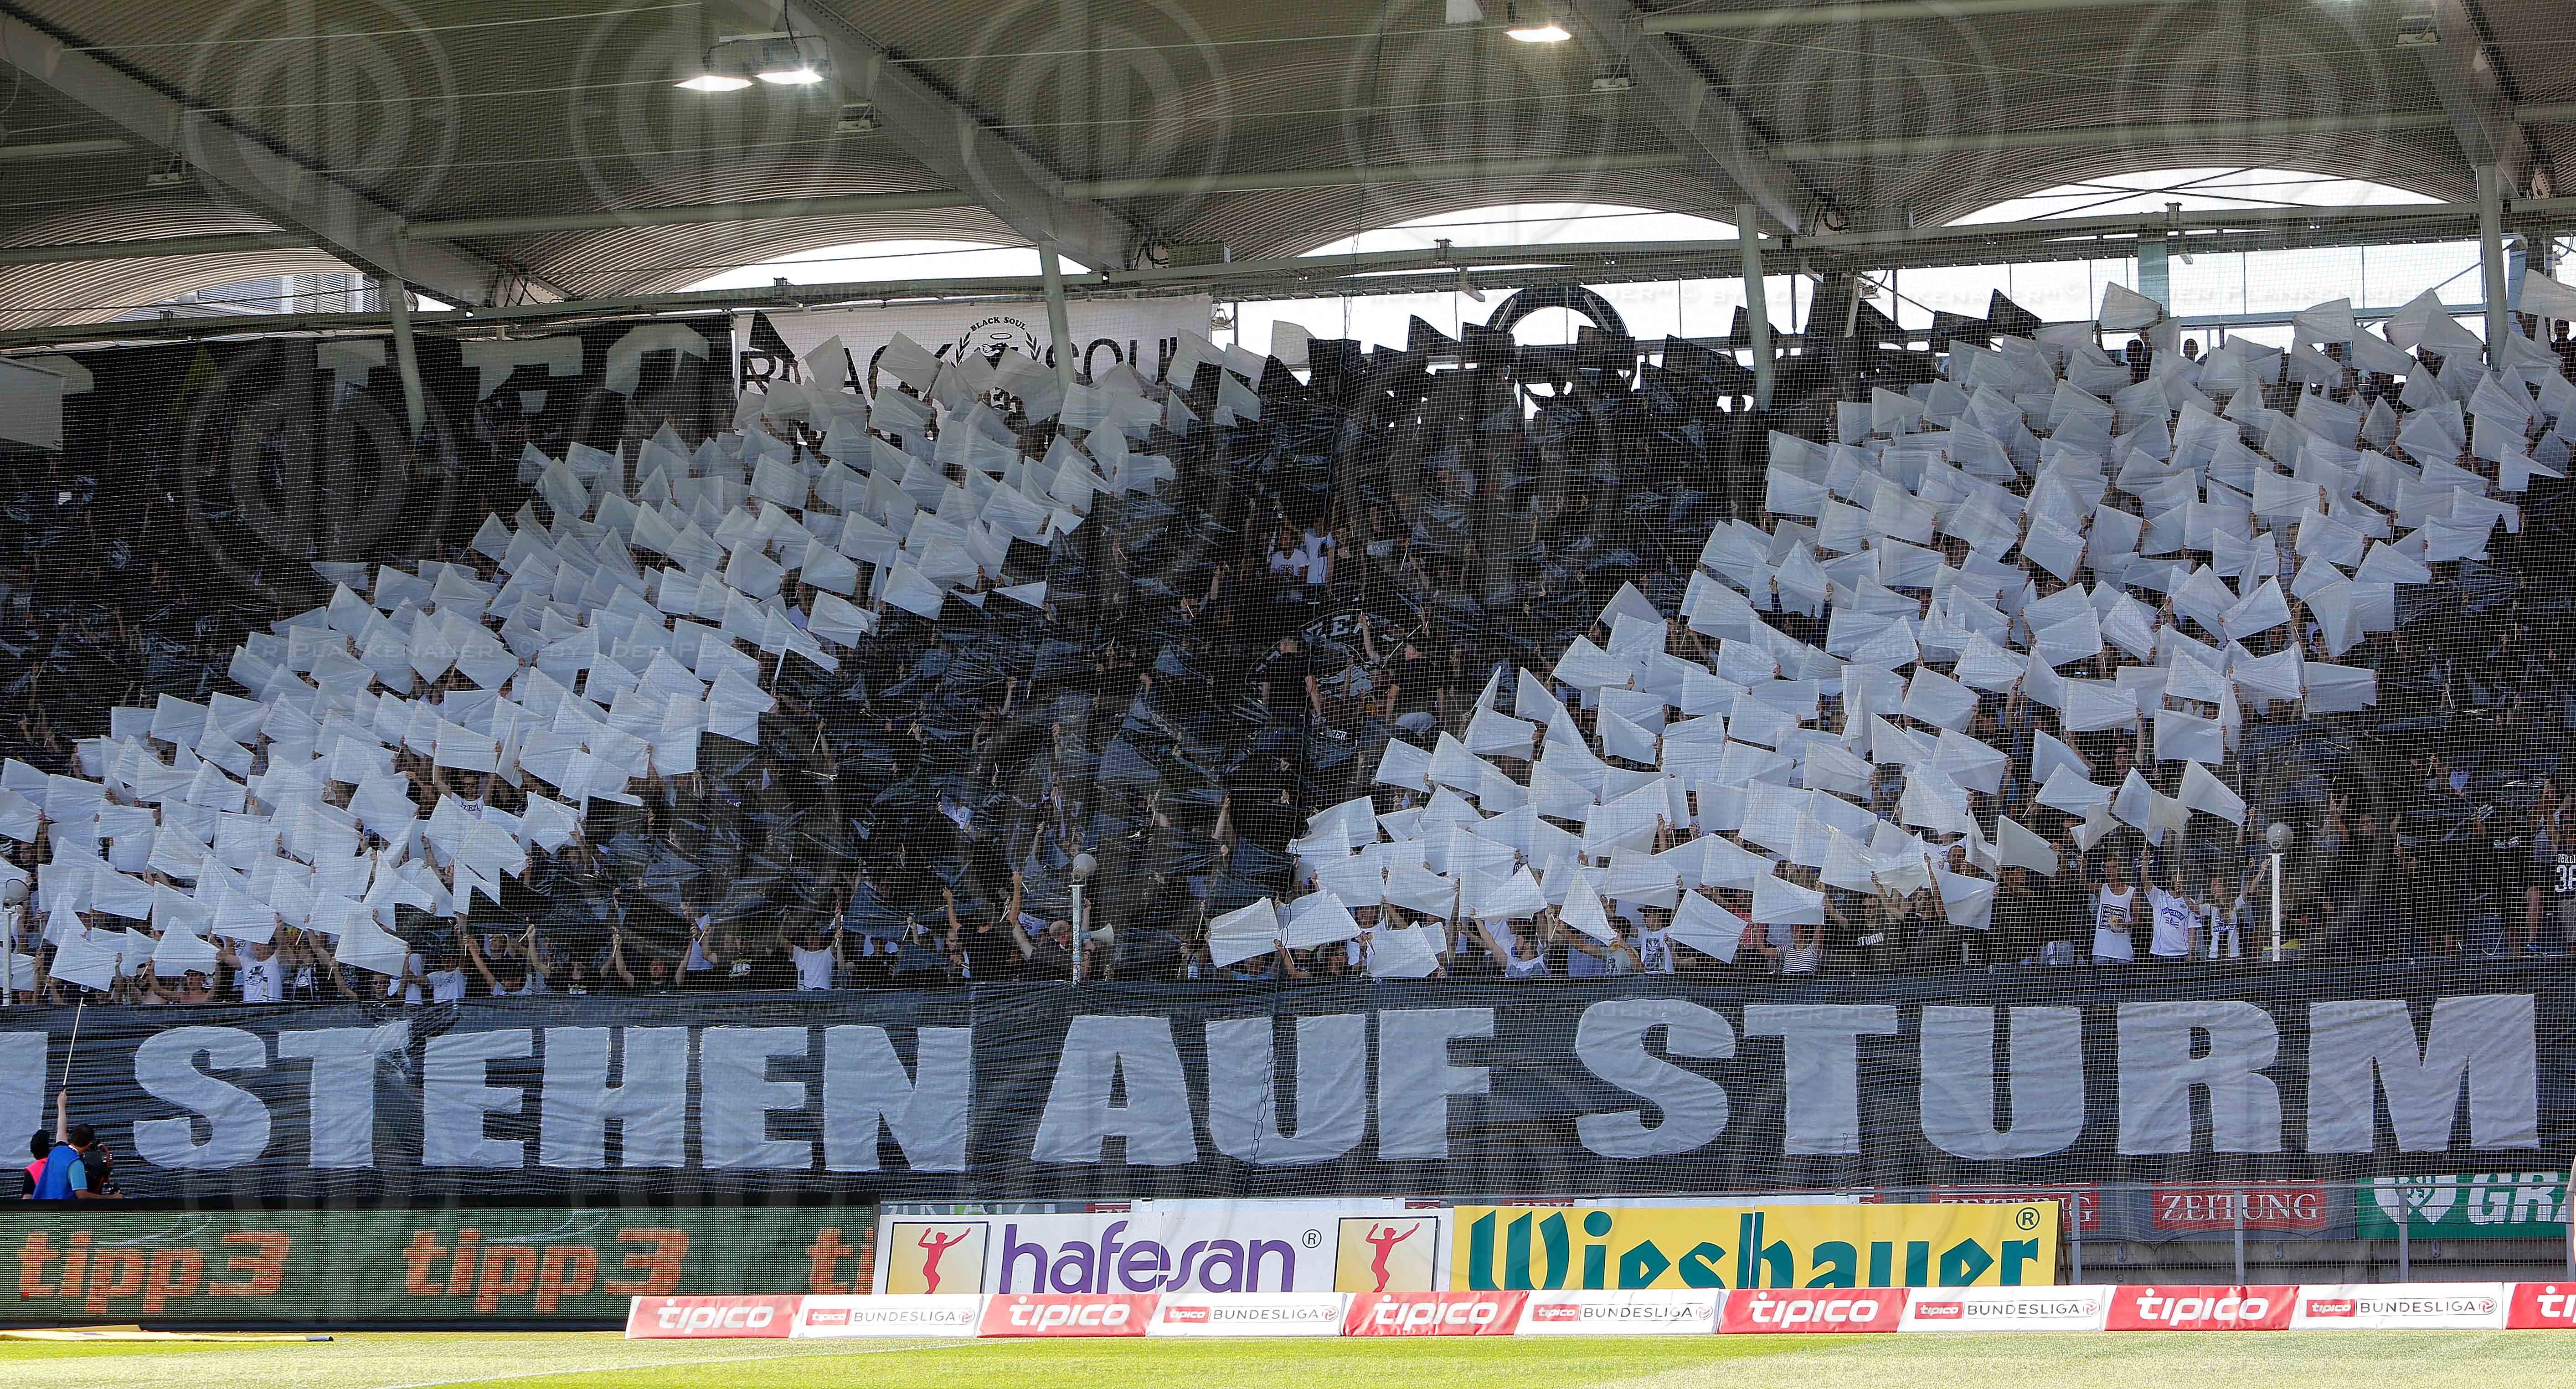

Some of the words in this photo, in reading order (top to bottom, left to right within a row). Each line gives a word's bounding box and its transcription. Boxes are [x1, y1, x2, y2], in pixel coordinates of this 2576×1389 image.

[970, 317, 1000, 332] BLACK
[1003, 316, 1027, 331] SOUL
[2558, 853, 2576, 864] BERLI
[1857, 932, 1884, 946] STURM
[133, 1020, 971, 1171] STEHEN
[1031, 1007, 1495, 1166] AUF
[1575, 994, 2540, 1160] STURM
[2161, 1192, 2317, 1222] ZEITUNG
[18, 1230, 292, 1315] tipp3
[402, 1227, 690, 1314] tipp3
[999, 1219, 1296, 1293] hafesan
[656, 1298, 775, 1335] tipico
[811, 1311, 847, 1323] tipico
[854, 1310, 956, 1322] BUNDESLIGA
[1008, 1295, 1131, 1332] tipico
[1169, 1309, 1206, 1321] tipico
[1213, 1308, 1319, 1321] BUNDESLIGA
[1373, 1294, 1499, 1331] tipico
[1536, 1306, 1577, 1318] tipico
[1583, 1306, 1692, 1319] BUNDESLIGA
[1749, 1290, 1879, 1329] tipico
[1919, 1304, 1960, 1317] tipico
[1968, 1303, 2080, 1317] BUNDESLIGA
[2136, 1287, 2269, 1327] tipico
[2311, 1302, 2352, 1314] tipico
[2360, 1300, 2476, 1313] BUNDESLIGA
[2536, 1284, 2576, 1325] ti
